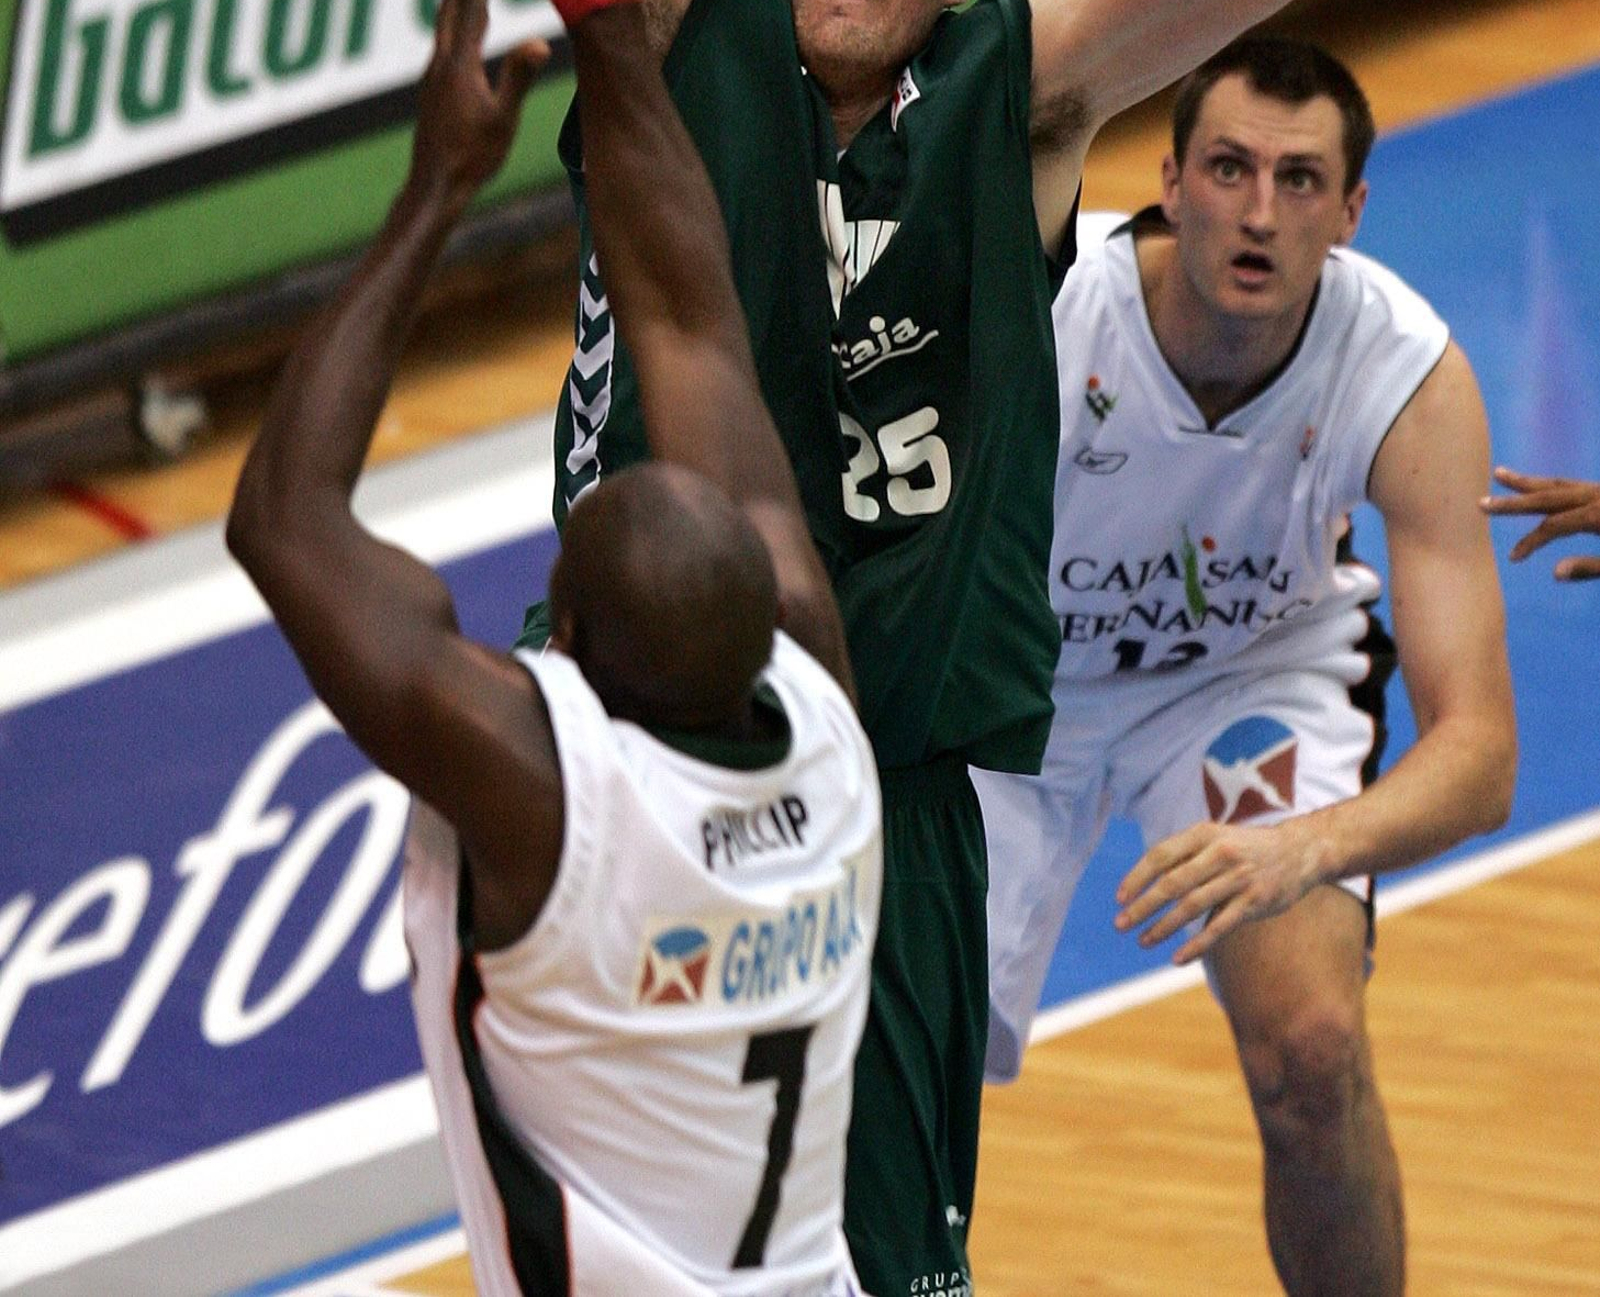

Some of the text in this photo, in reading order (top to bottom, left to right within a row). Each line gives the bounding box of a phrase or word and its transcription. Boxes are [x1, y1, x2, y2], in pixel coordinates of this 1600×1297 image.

[838, 406, 951, 523] 25
[1060, 552, 1180, 597] CAJA
[730, 1024, 816, 1270] 7
